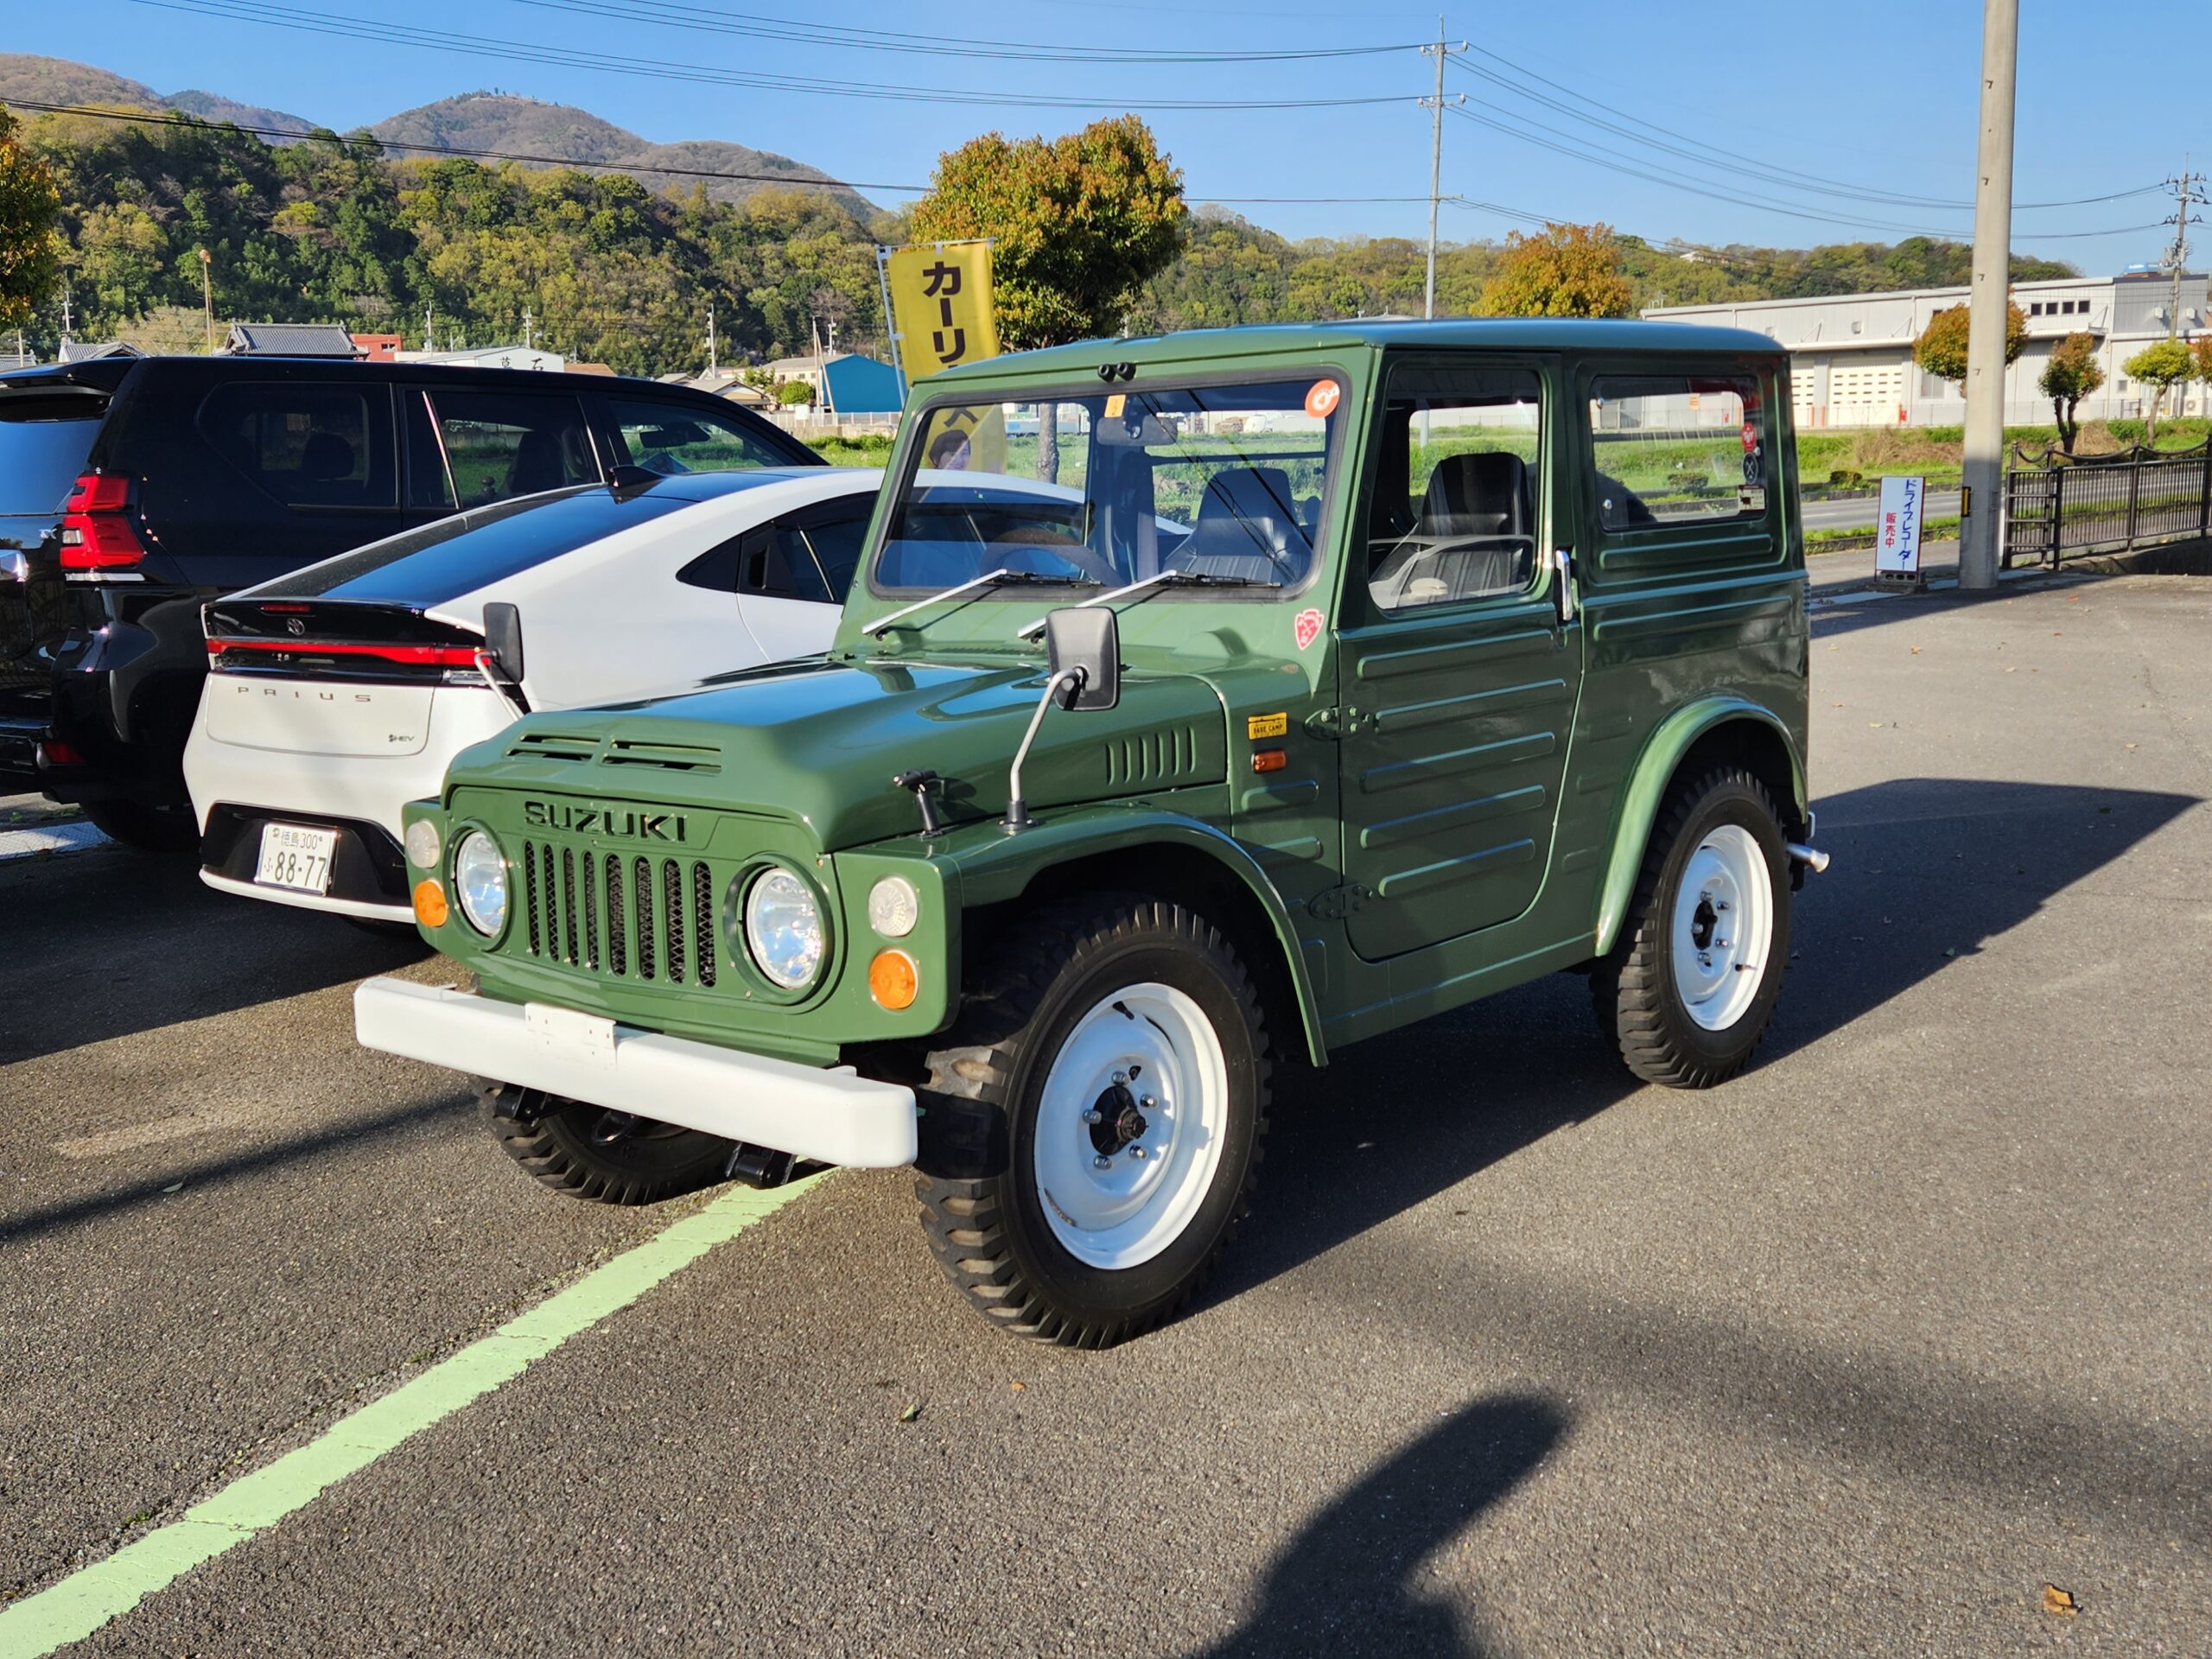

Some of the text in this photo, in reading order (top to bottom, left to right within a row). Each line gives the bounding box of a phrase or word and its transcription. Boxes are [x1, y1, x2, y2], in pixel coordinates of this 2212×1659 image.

[1885, 512, 1897, 548] 販売中
[1898, 479, 1916, 570] ドライブレコーダー
[238, 686, 372, 702] PRIUS
[1268, 723, 1283, 732] CAMP
[524, 801, 688, 843] SUZUKI
[300, 832, 318, 850] 300
